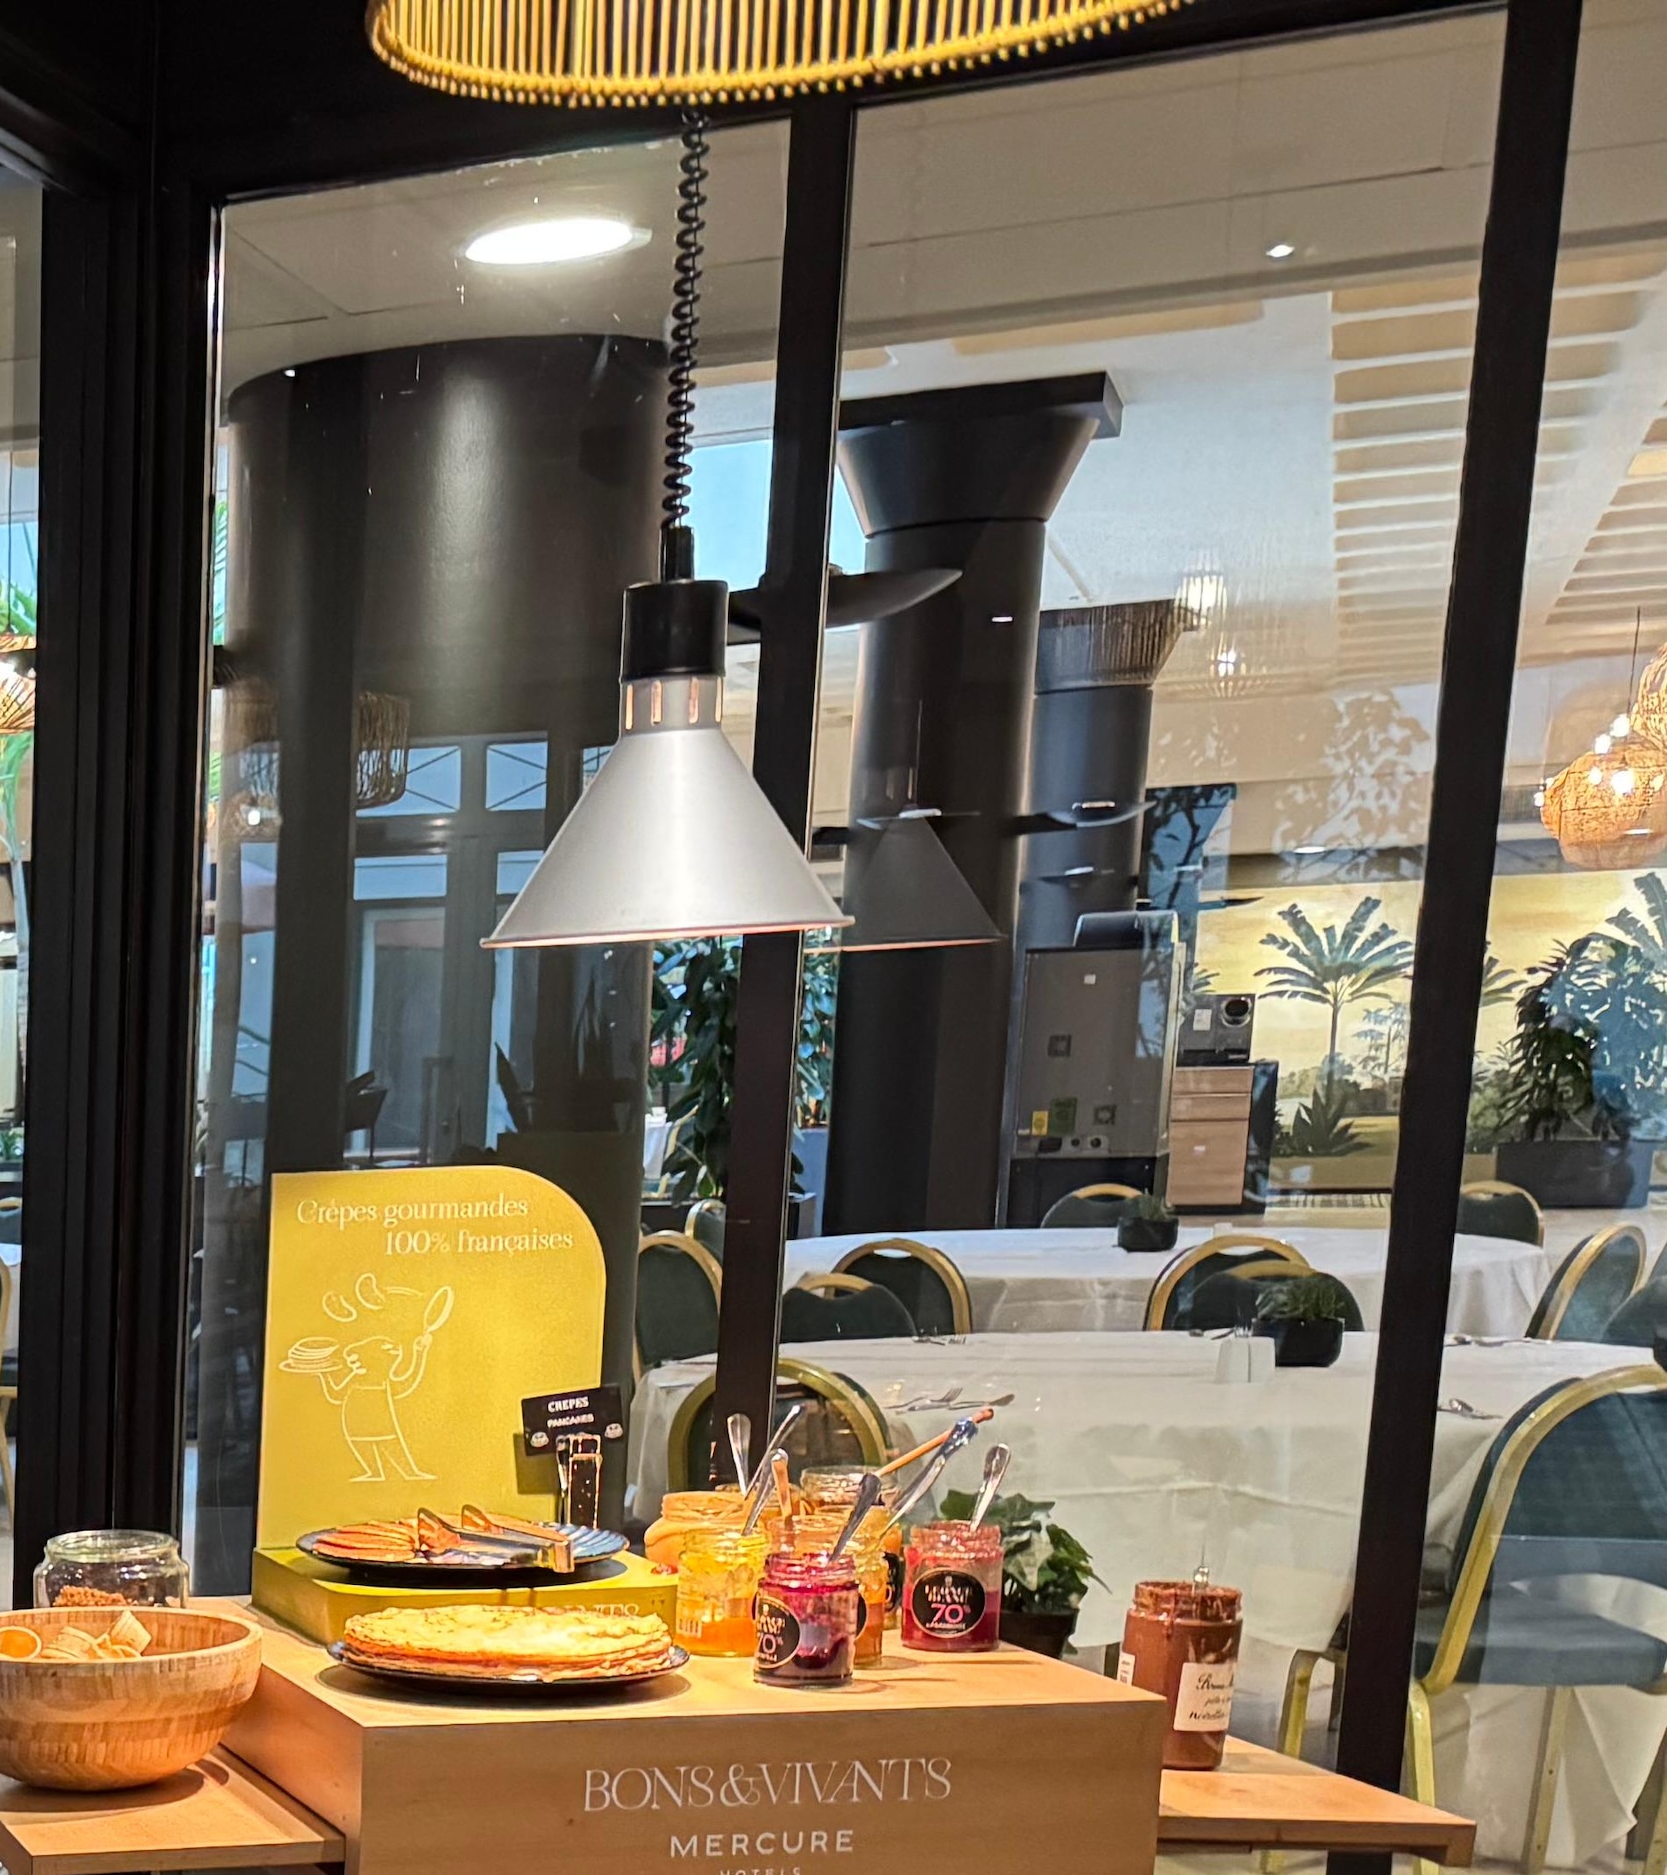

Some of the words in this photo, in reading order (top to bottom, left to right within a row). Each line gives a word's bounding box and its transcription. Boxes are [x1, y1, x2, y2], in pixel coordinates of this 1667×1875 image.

[383, 1193, 529, 1228] gourmandes
[384, 1230, 451, 1256] 100%
[457, 1227, 574, 1257] françaises
[669, 1829, 854, 1858] MERCURE
